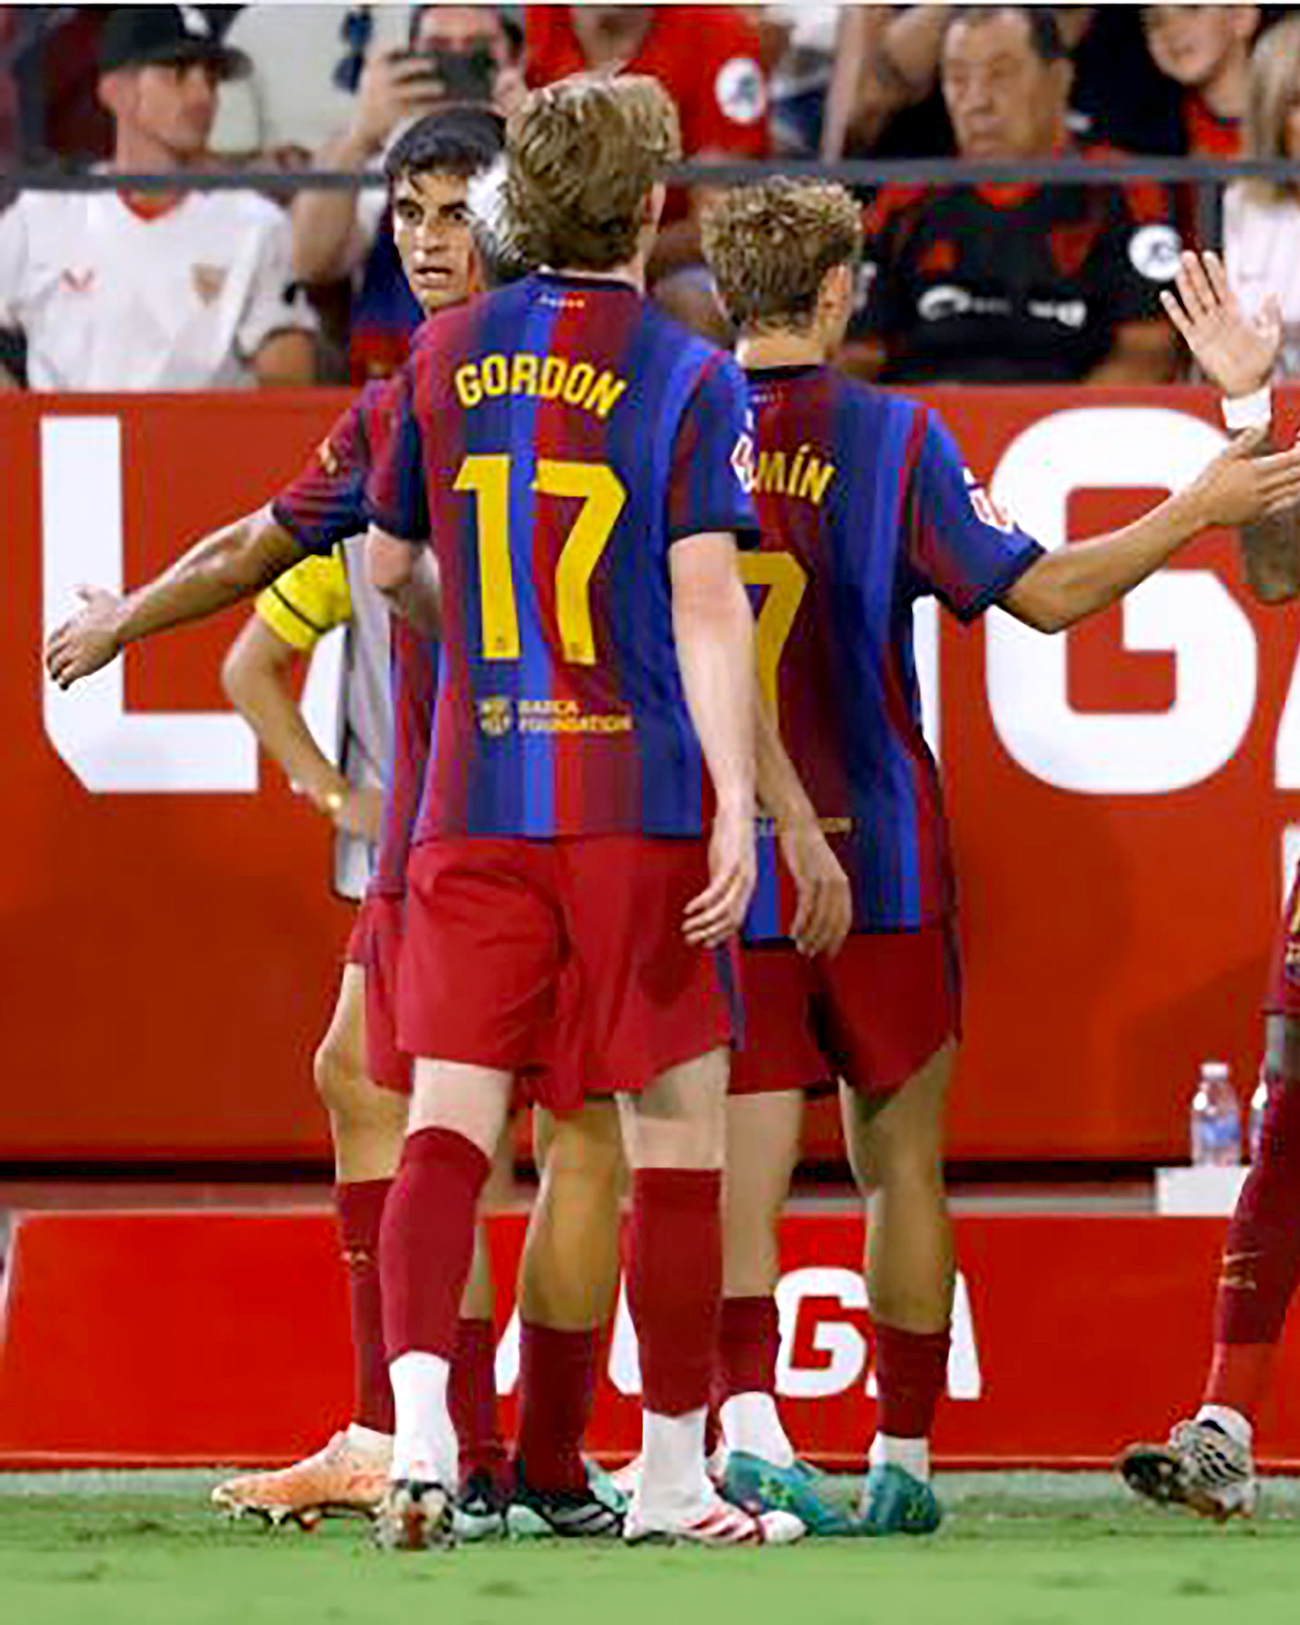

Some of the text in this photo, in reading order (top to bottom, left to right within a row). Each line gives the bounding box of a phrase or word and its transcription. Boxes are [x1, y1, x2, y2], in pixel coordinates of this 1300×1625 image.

[455, 352, 628, 418] GORDON
[756, 443, 836, 504] MÍN
[453, 454, 628, 666] 17
